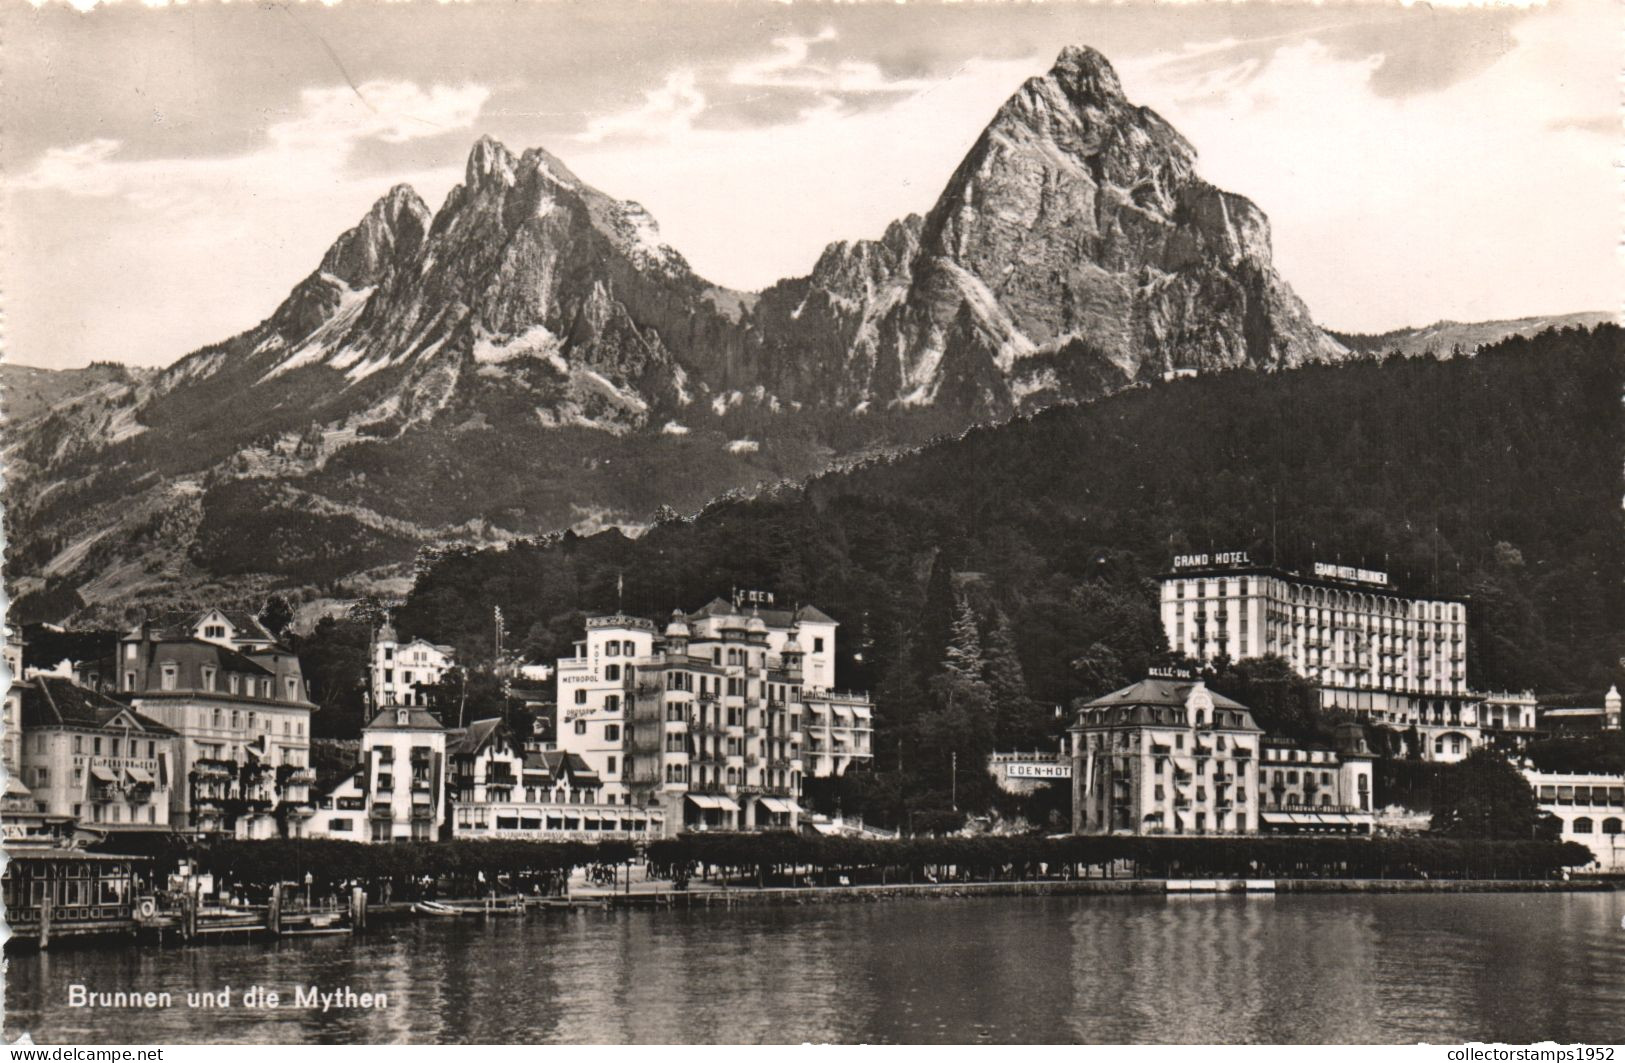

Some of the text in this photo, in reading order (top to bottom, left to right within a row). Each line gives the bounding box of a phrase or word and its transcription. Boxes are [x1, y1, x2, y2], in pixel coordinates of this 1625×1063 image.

[1174, 551, 1250, 568] GRAND HOTEL
[739, 589, 774, 604] EDEN
[562, 675, 599, 683] METROPOL
[1009, 764, 1074, 777] EDEN-HOT
